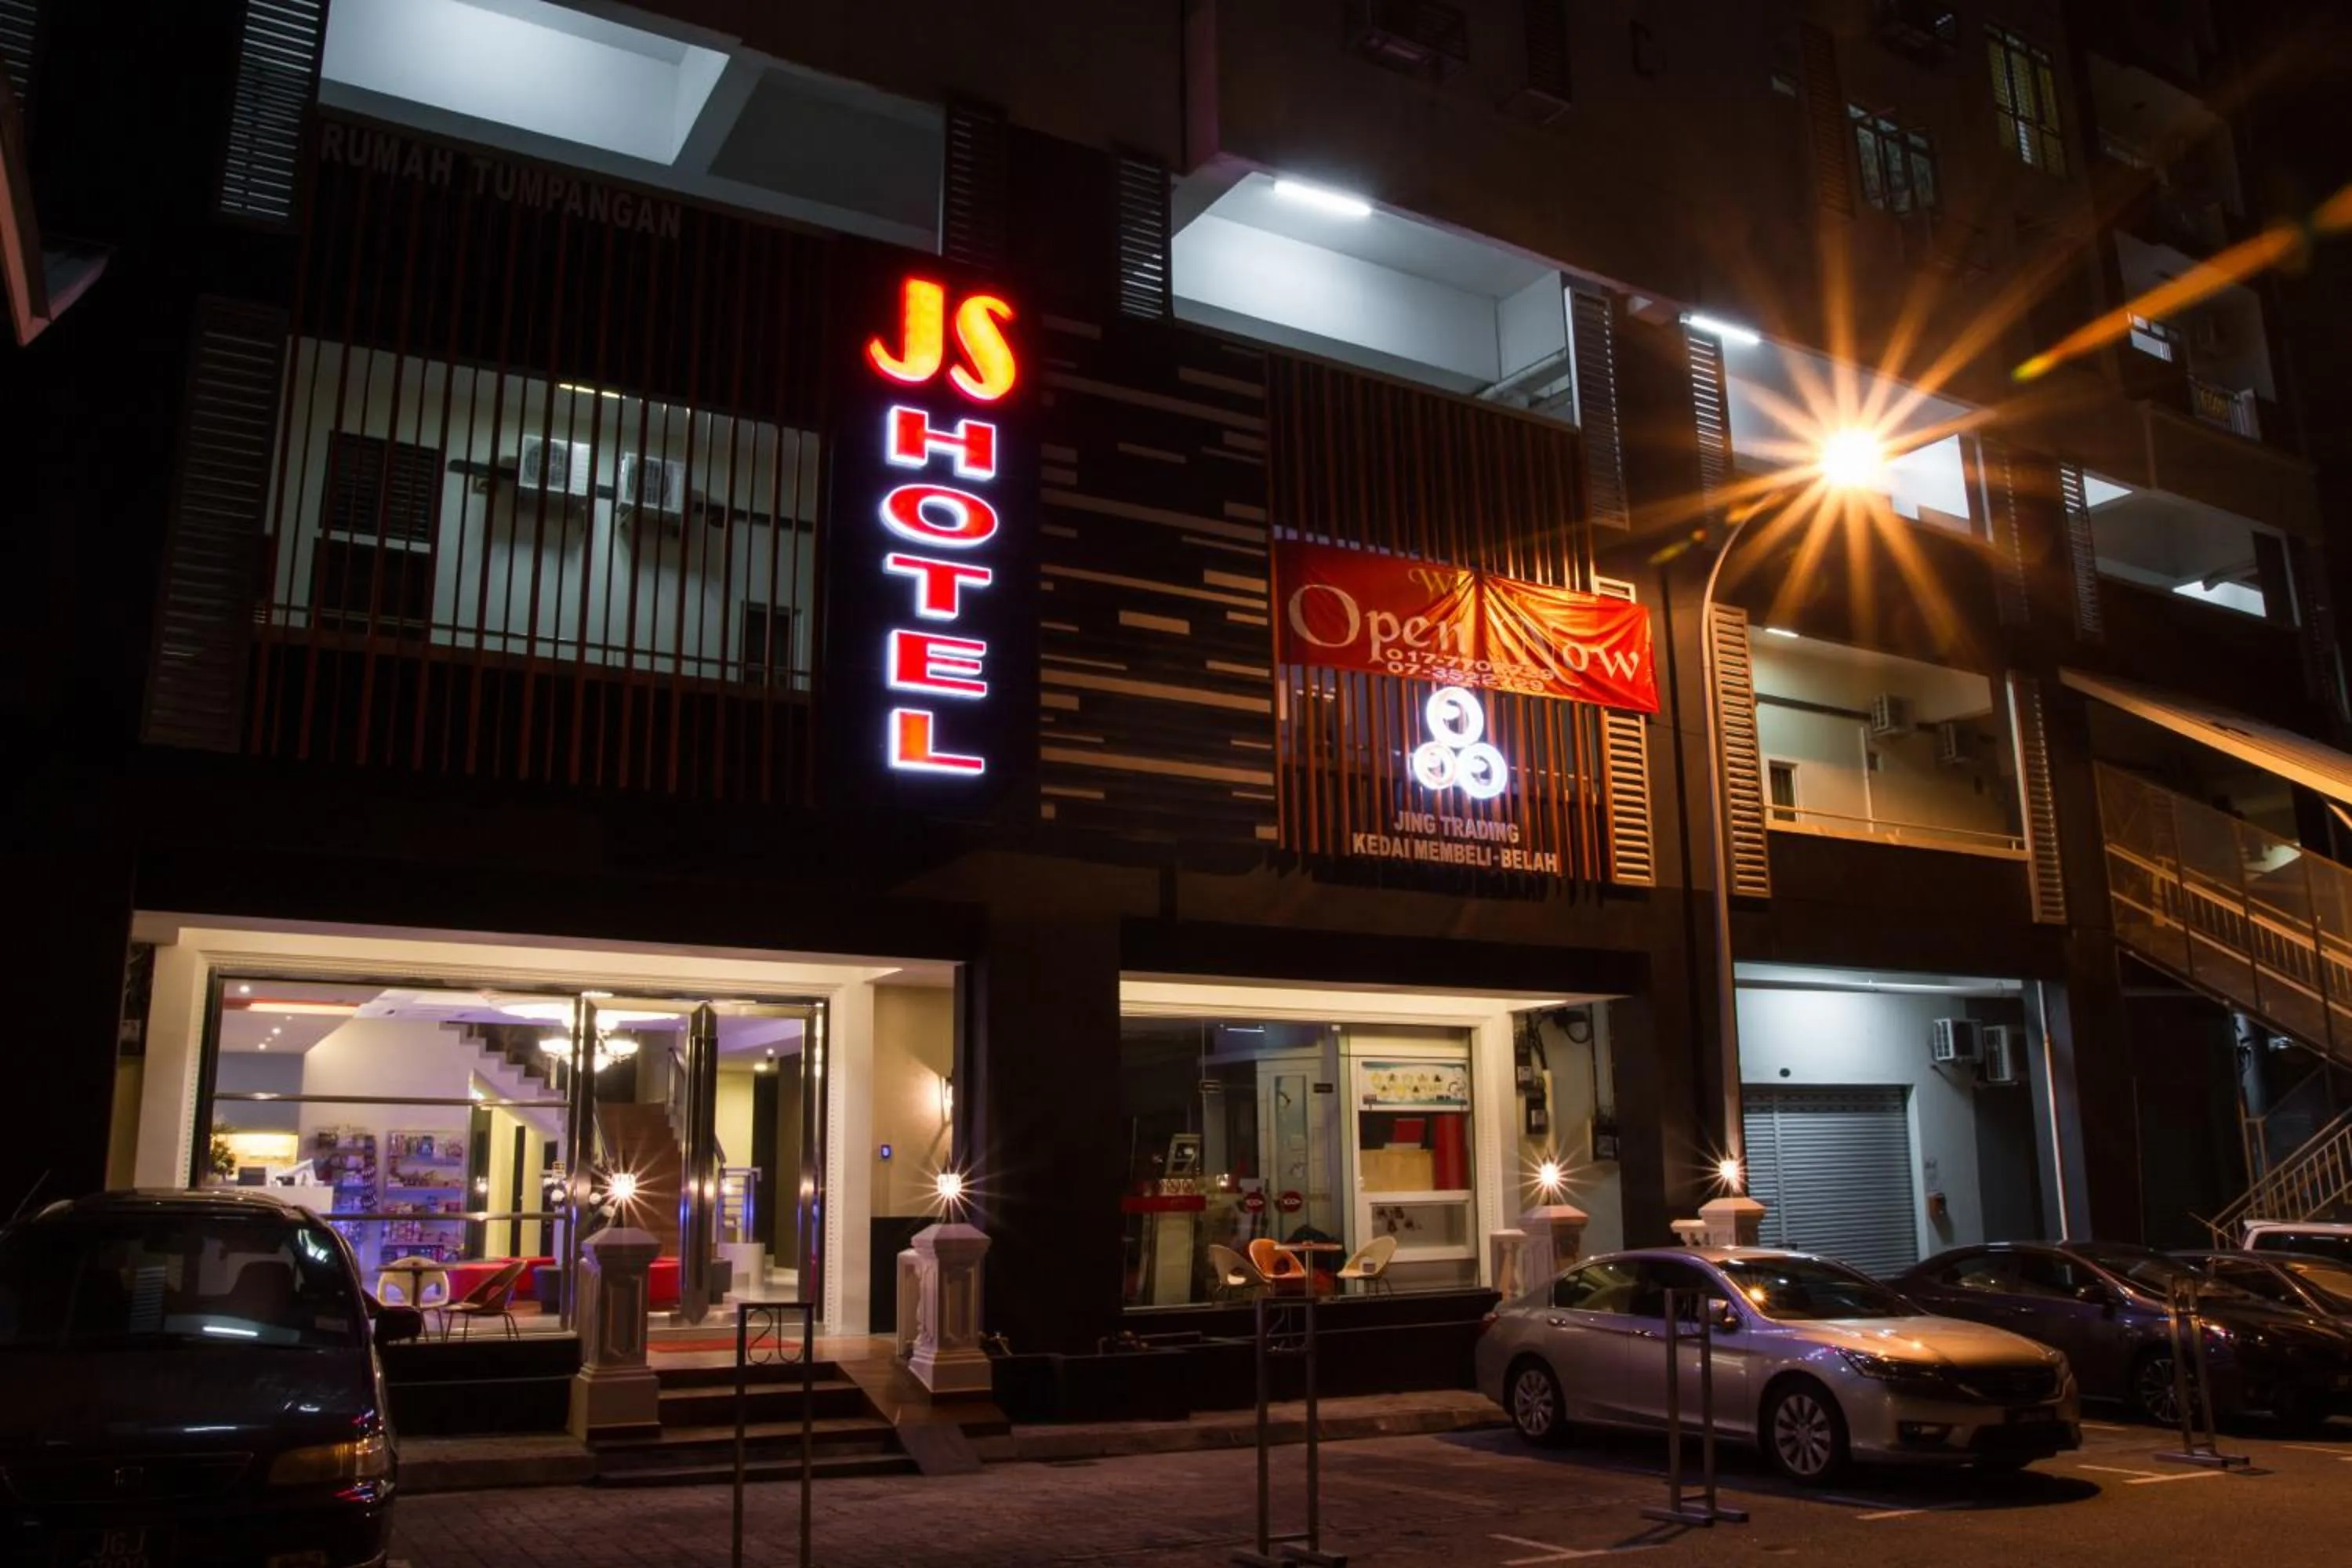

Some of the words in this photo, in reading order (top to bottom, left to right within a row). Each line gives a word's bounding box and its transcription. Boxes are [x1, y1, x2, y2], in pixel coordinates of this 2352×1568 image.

[321, 122, 453, 187] RUMAH
[473, 158, 683, 239] TUMPANGAN
[867, 277, 1016, 403] JS
[880, 404, 1000, 775] HOTEL
[1287, 583, 1474, 663] Open
[1352, 832, 1410, 858] KEDAI
[1394, 810, 1436, 834] JING
[1439, 816, 1520, 844] TRADING
